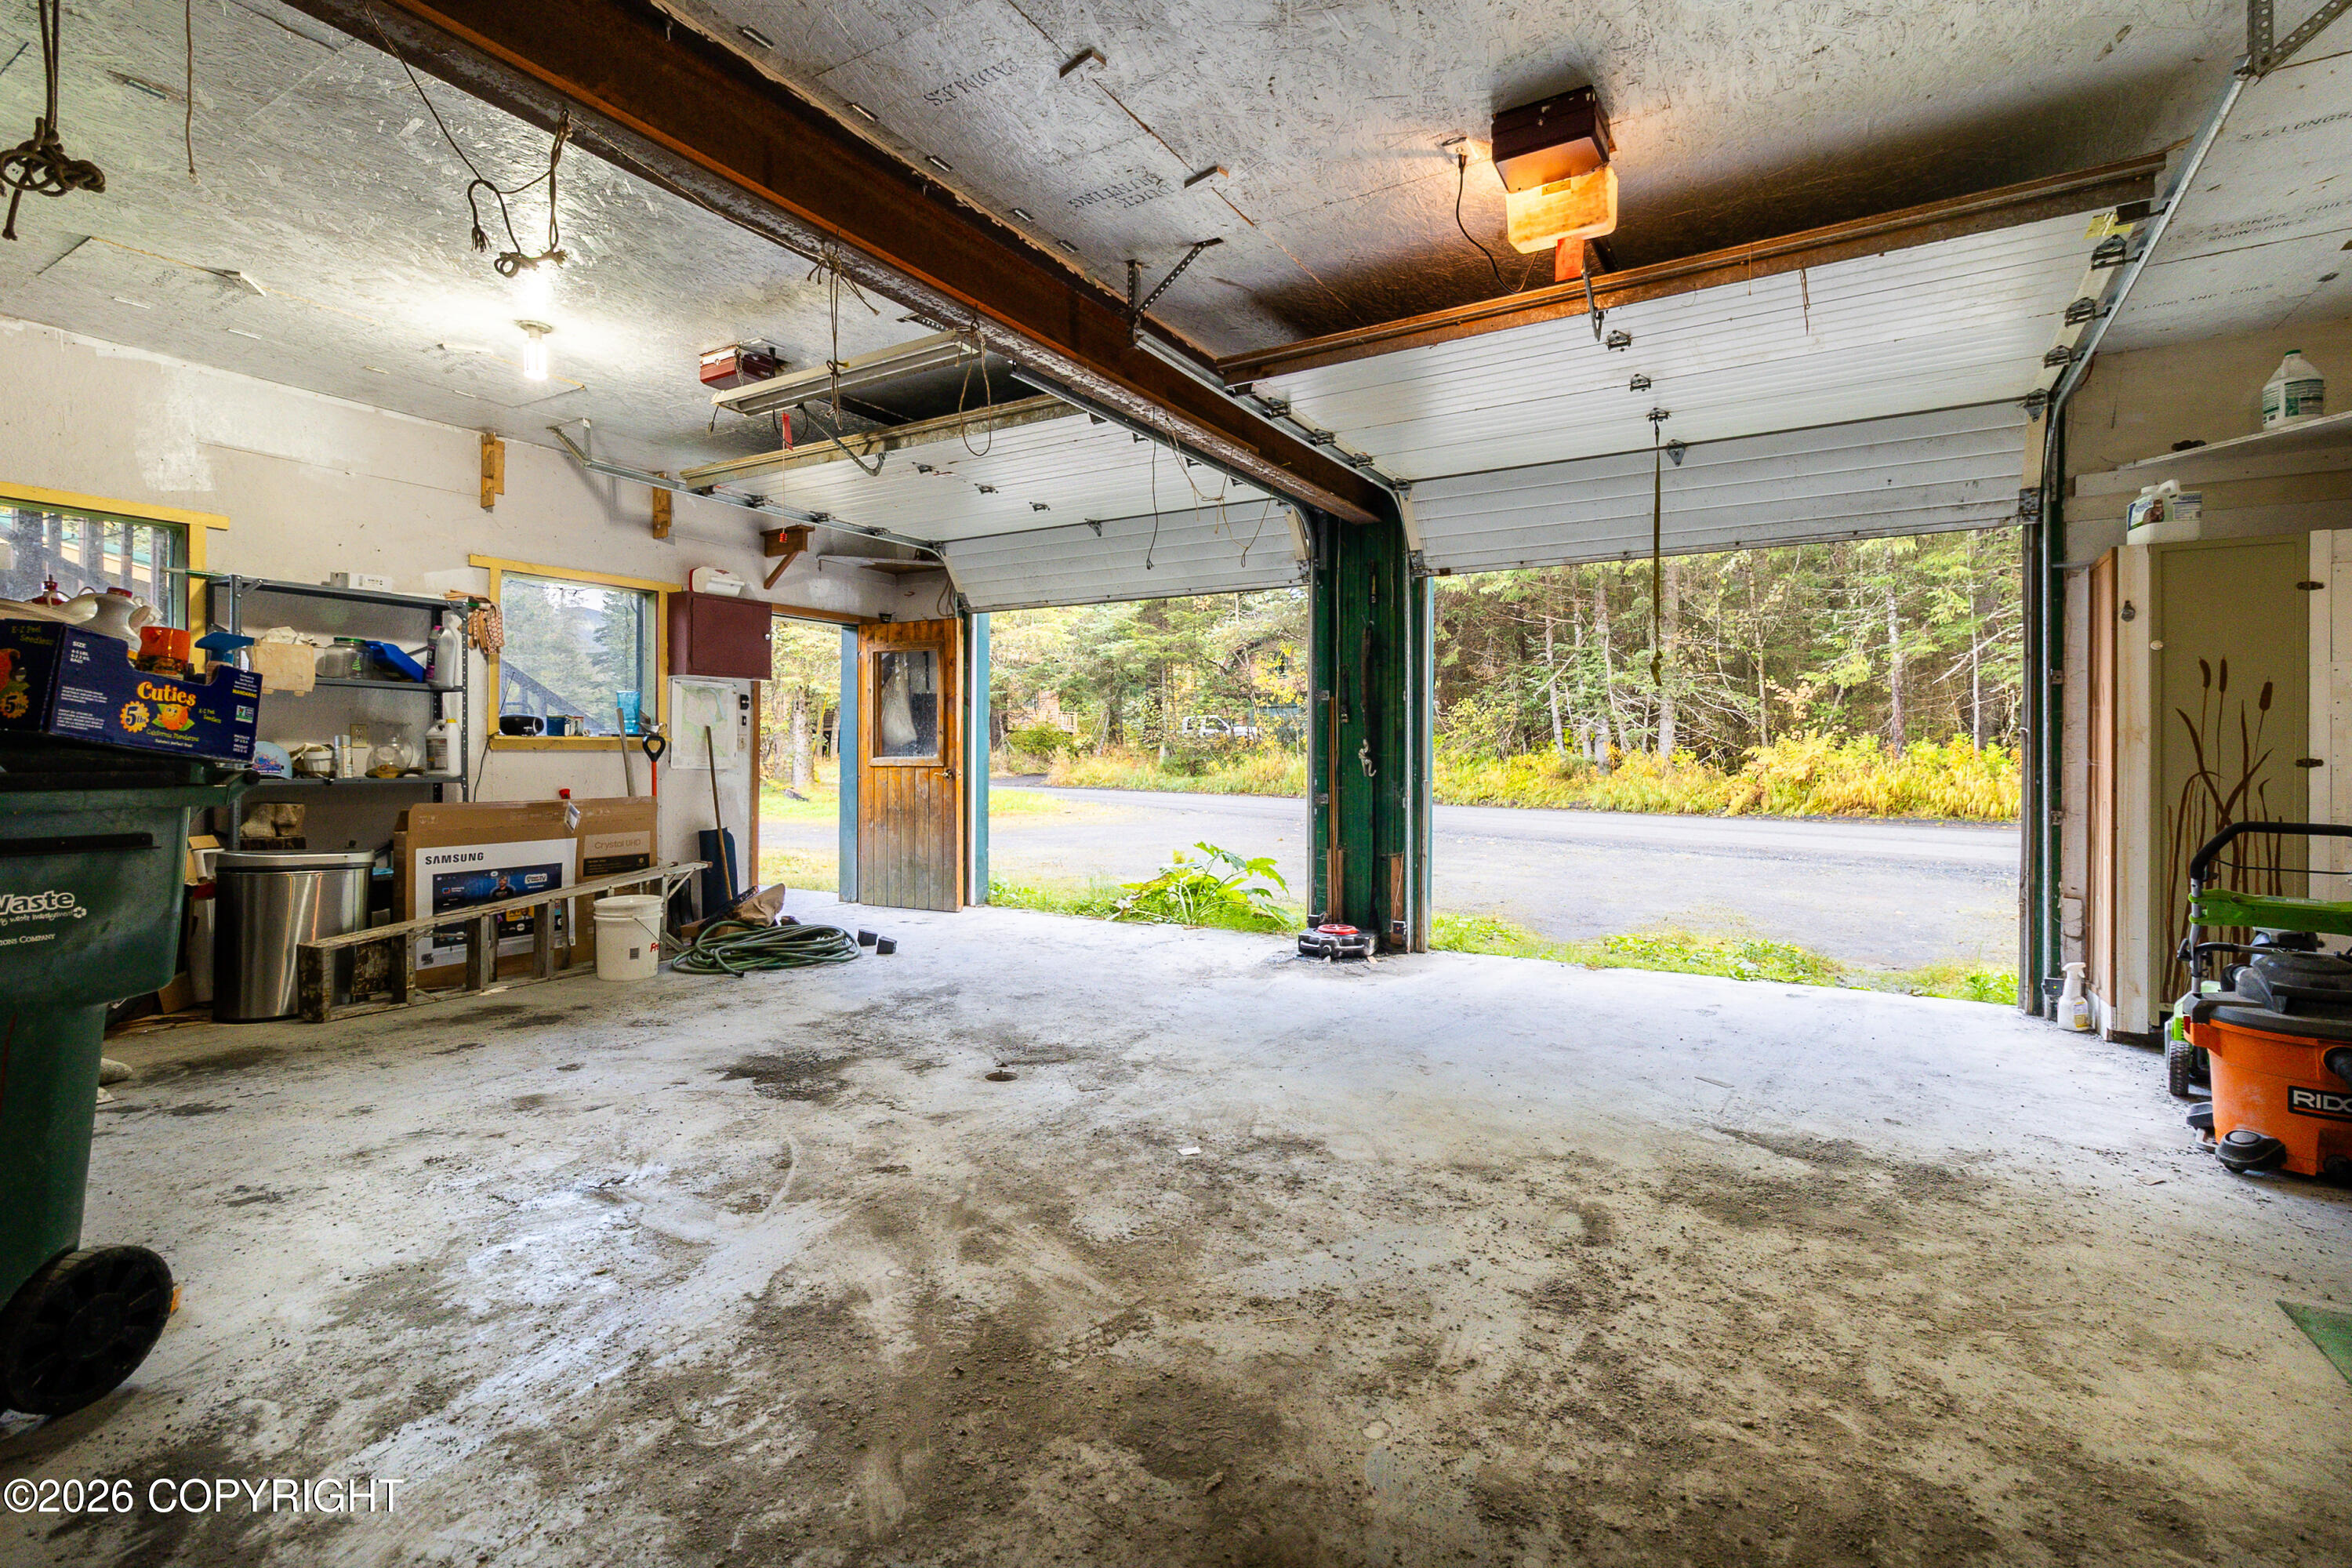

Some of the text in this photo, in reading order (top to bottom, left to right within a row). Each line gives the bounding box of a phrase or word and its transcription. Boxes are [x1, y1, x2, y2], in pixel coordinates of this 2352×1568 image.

[1067, 173, 1157, 209] HUNTING
[1114, 183, 1175, 208] DUCK
[137, 681, 197, 707] Cuties
[125, 706, 139, 726] 5
[594, 839, 641, 851] Crystal UHD
[425, 852, 485, 866] SAMSUNG
